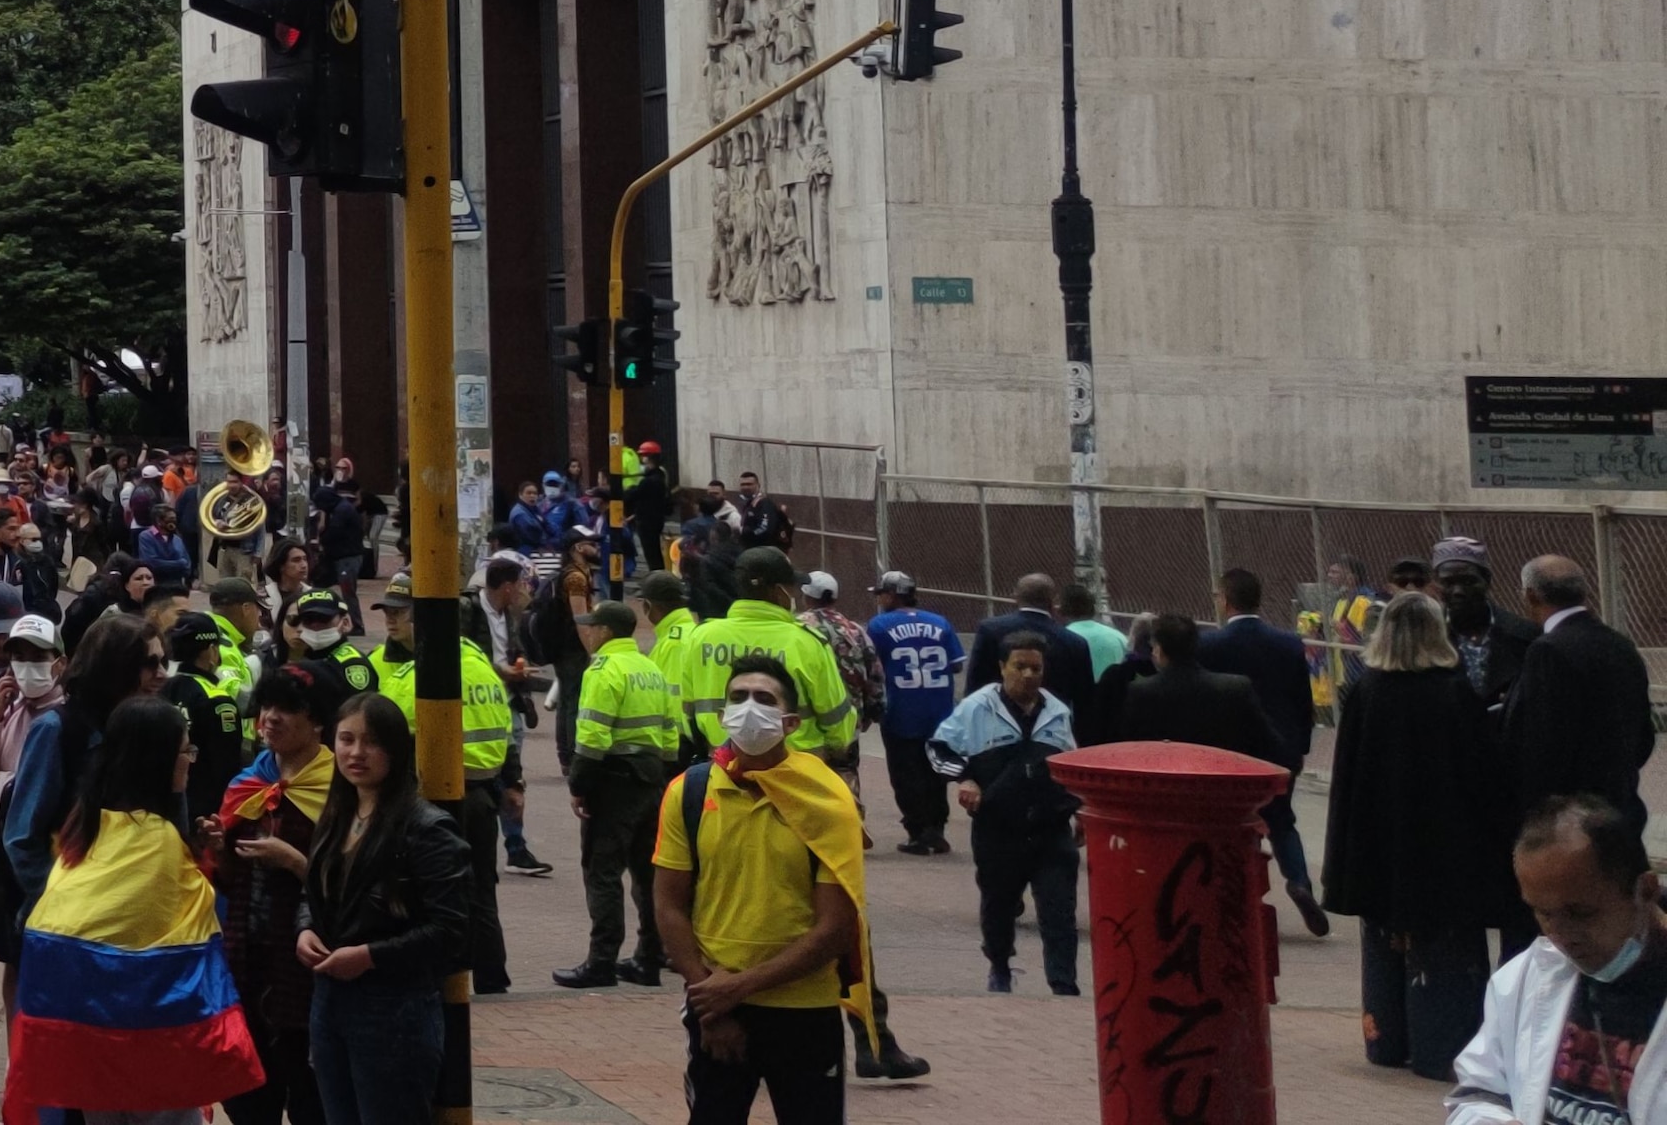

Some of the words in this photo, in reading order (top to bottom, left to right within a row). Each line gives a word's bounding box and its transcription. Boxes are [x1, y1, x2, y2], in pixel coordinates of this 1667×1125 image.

[920, 288, 945, 297] Calle
[1486, 384, 1522, 393] Centro
[1524, 384, 1596, 394] Internacional
[1488, 412, 1531, 421] Avenida
[1533, 412, 1571, 421] Ciudad
[1572, 413, 1585, 421] de
[1587, 413, 1615, 422] Lima
[888, 622, 943, 643] KOUFAX
[891, 645, 950, 689] 32
[463, 684, 504, 705] ICIA
